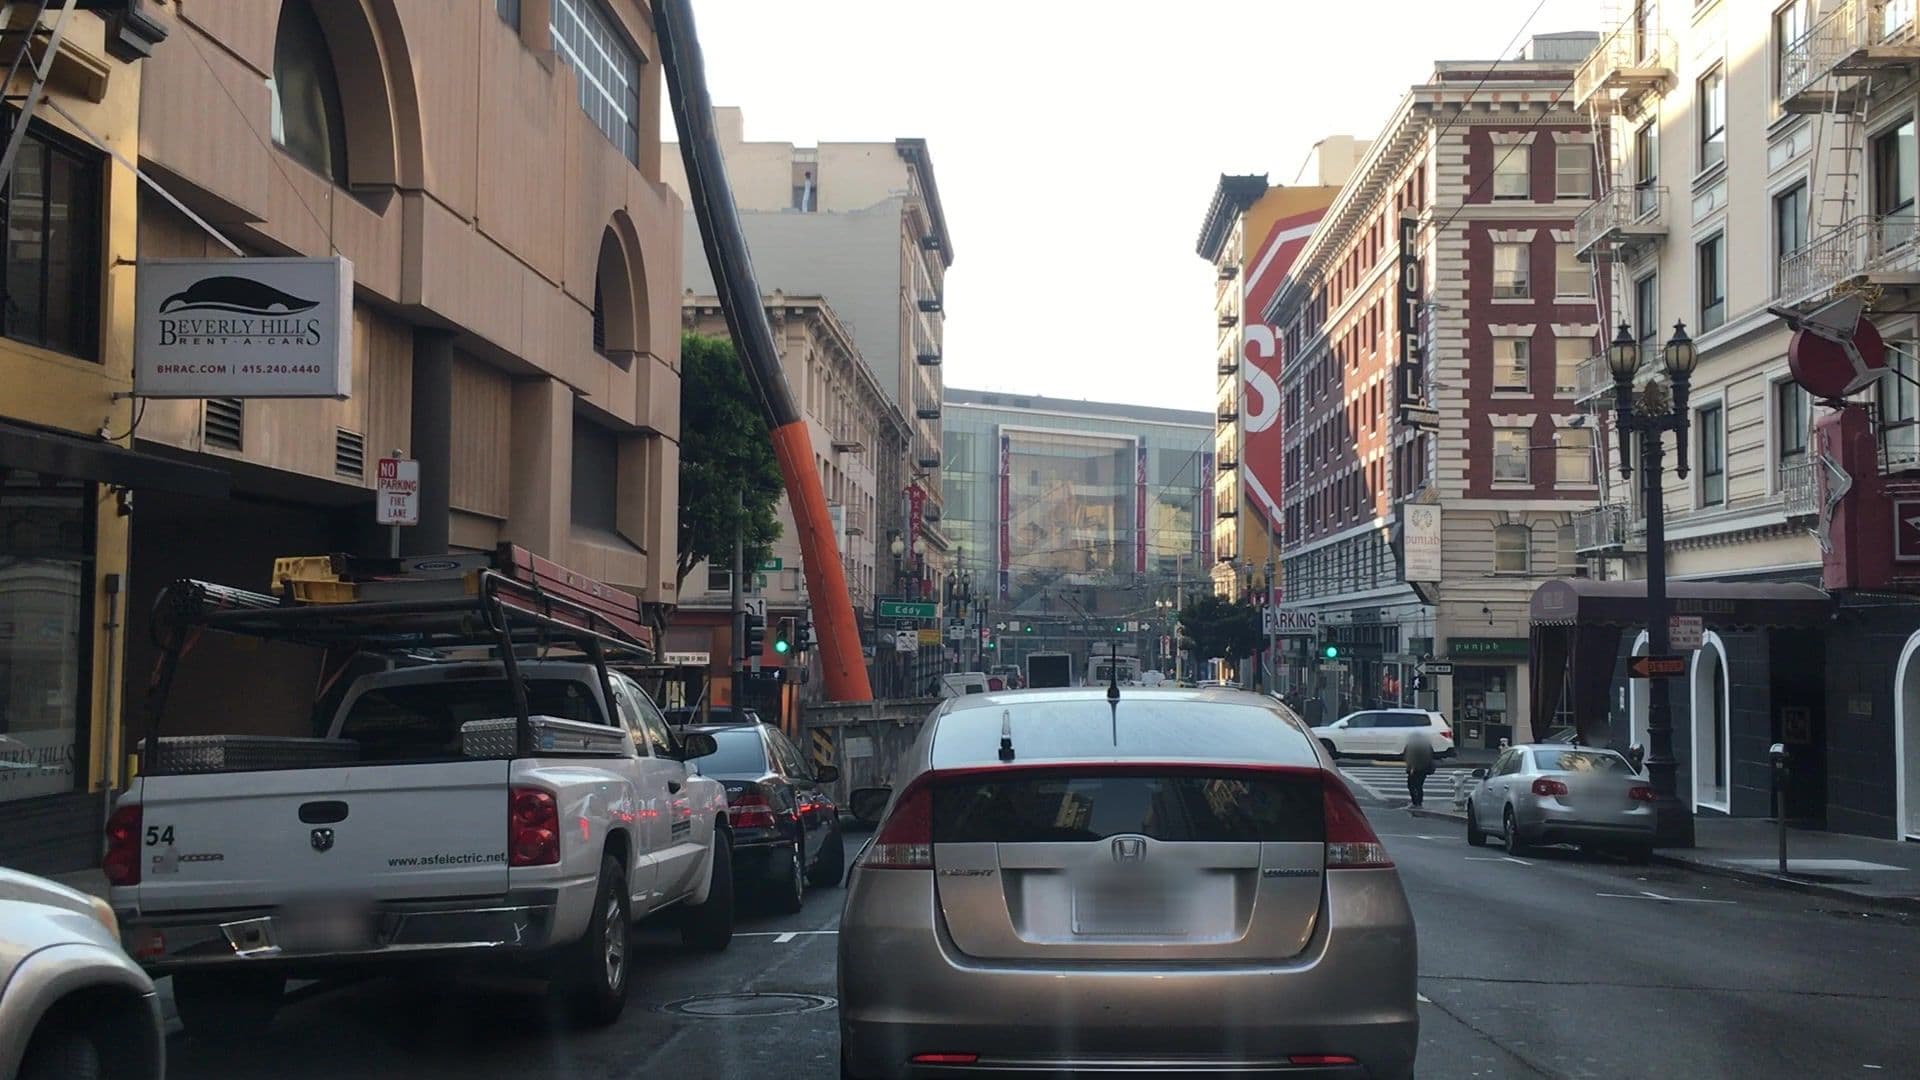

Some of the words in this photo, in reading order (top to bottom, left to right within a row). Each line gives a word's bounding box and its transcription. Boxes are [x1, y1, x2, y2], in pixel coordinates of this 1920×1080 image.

[1406, 226, 1418, 399] HOTEL
[158, 319, 253, 346] BEVERLY
[261, 319, 321, 346] HILLS
[157, 364, 227, 374] BHRAC.COM
[241, 364, 321, 374] 415.240.4440
[1245, 323, 1281, 433] S
[380, 462, 396, 478] NO
[380, 480, 417, 492] PARKING
[390, 496, 406, 507] FIRE
[388, 508, 407, 519] LANE
[895, 605, 921, 616] Eddy
[1265, 612, 1317, 629] PARKING
[1455, 641, 1499, 652] punjab
[145, 825, 175, 847] 54
[388, 852, 506, 867] www.asfelectric.net
